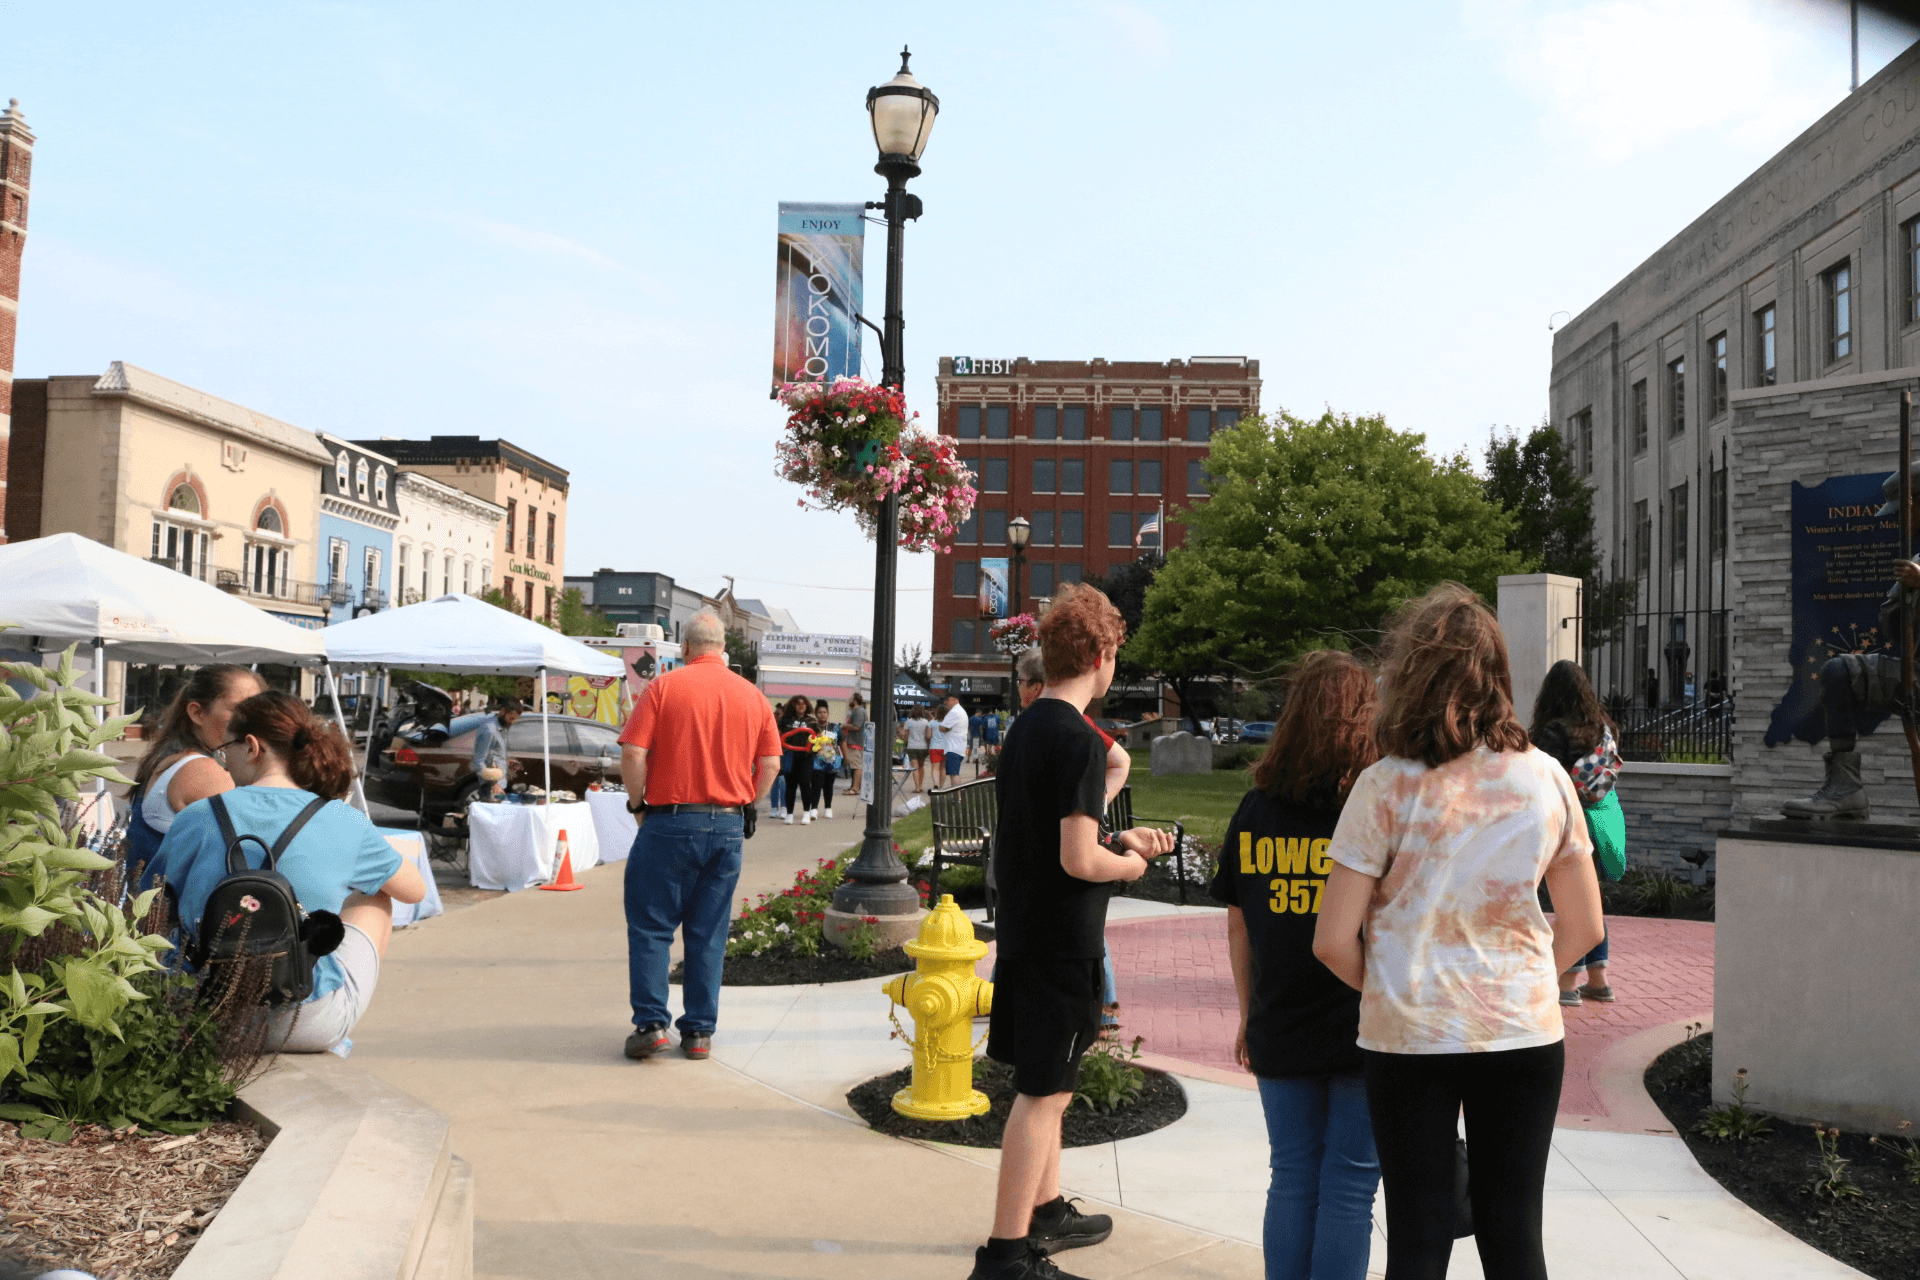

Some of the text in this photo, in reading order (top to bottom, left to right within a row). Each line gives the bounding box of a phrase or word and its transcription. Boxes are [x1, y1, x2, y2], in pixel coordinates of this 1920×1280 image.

[1662, 222, 1735, 292] HOWARD
[1750, 139, 1839, 226] COUNTY
[801, 219, 842, 232] ENJOY
[804, 252, 832, 377] KOKOMO
[971, 358, 1014, 375] FFBT
[1828, 503, 1886, 519] INDIAN
[1805, 524, 1843, 534] Women's
[1846, 522, 1876, 533] Legacy
[766, 634, 810, 643] ELEPHANT
[824, 637, 857, 645] FUNNEL
[776, 643, 797, 651] EARS
[1269, 878, 1326, 914] 357
